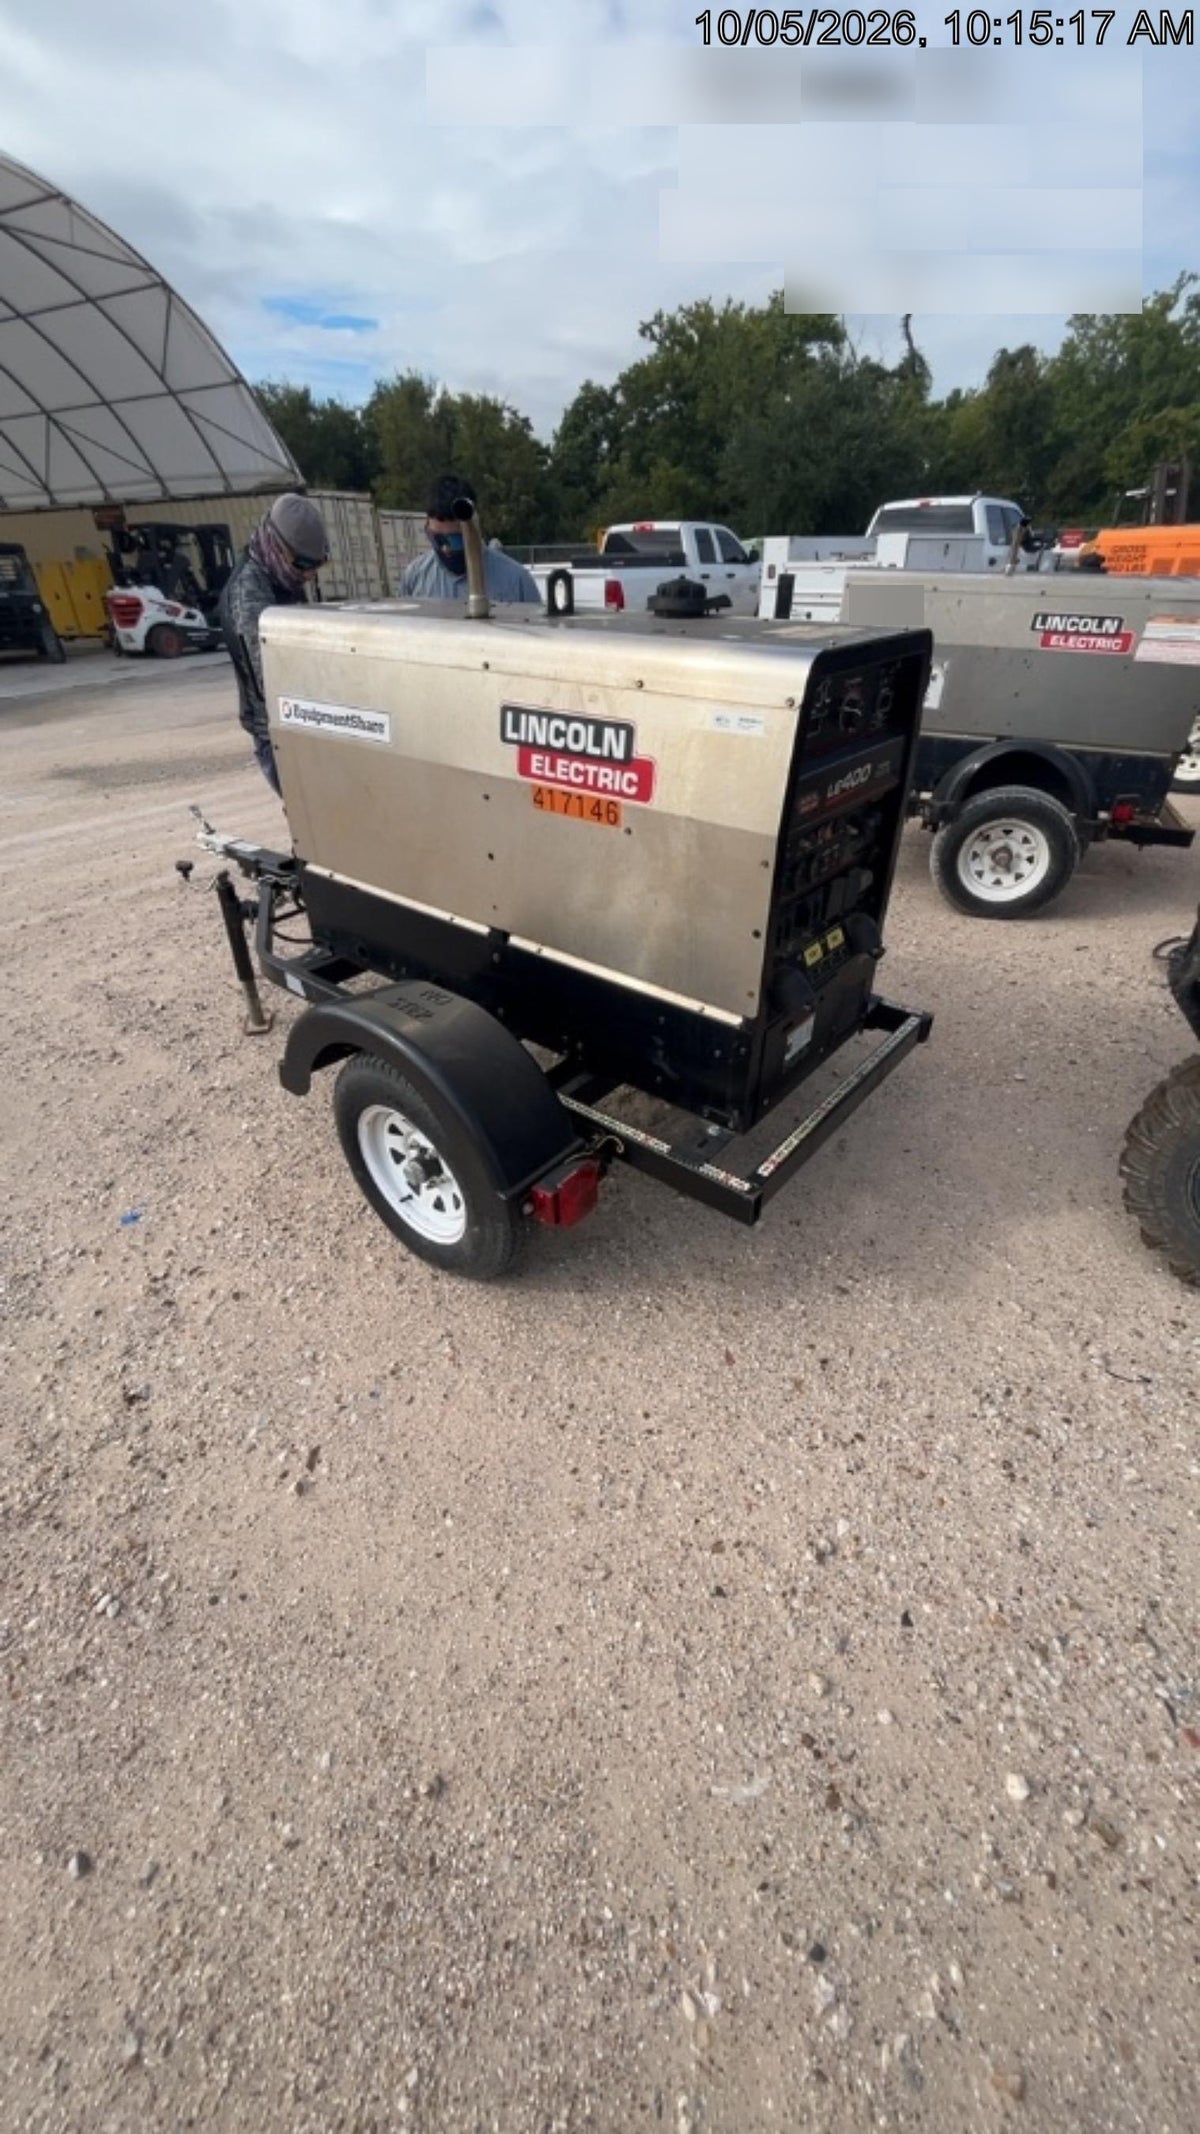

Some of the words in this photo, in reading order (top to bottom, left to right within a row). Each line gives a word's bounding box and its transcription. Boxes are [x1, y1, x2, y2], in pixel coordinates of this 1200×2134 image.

[1034, 616, 1119, 634] LINCOLN
[1050, 635, 1122, 650] ELECTRIC
[293, 704, 385, 735] EquipmentShare
[504, 711, 627, 760] LINCOLN
[530, 753, 639, 795] ELECTRIC
[533, 787, 619, 826] 417146
